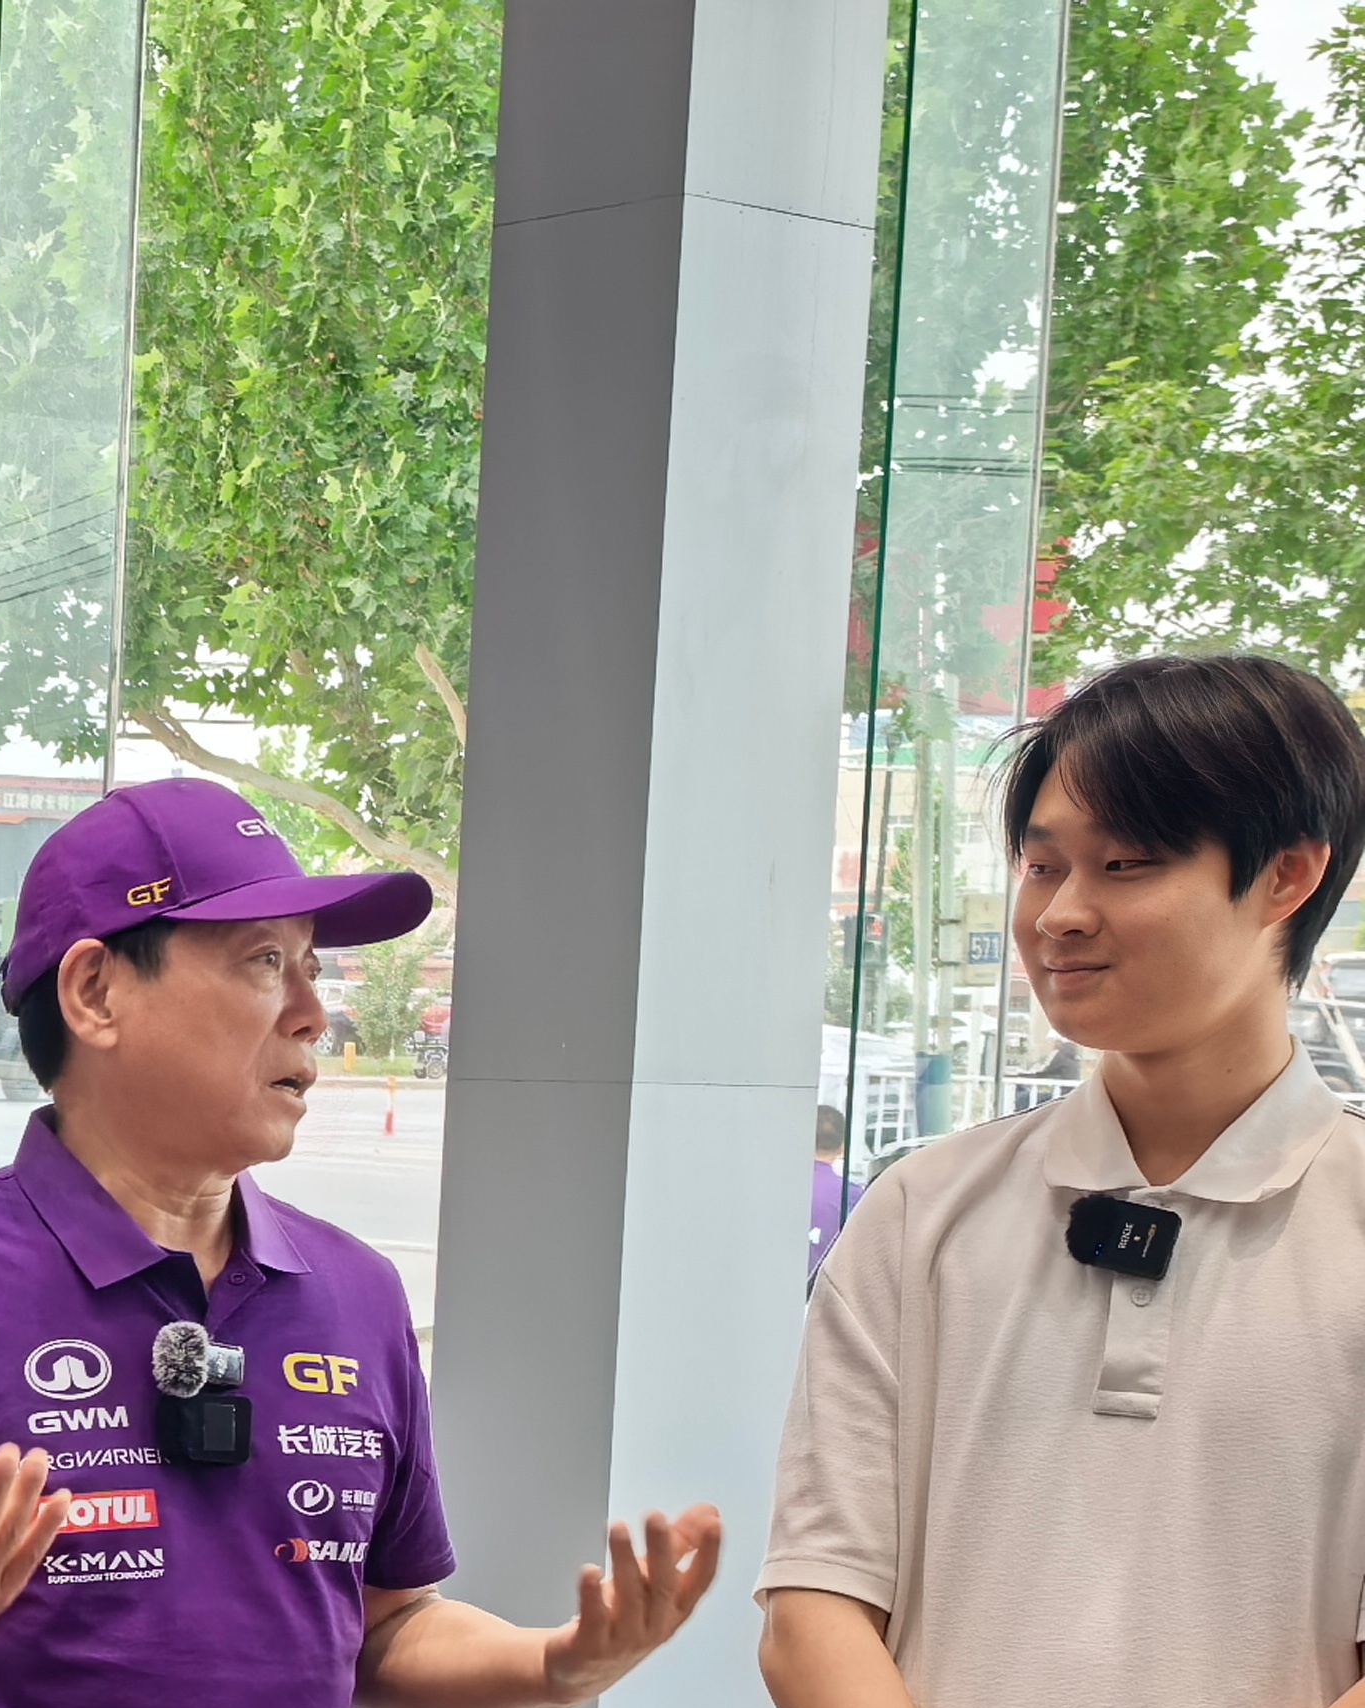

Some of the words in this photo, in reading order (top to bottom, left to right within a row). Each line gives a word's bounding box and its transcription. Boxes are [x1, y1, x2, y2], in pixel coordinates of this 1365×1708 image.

[127, 877, 171, 906] GF
[282, 1351, 359, 1395] GF
[27, 1405, 130, 1434] GWM
[277, 1424, 384, 1459] 长城汽车
[47, 1447, 170, 1471] RGWARNE
[38, 1495, 152, 1528] OTUL
